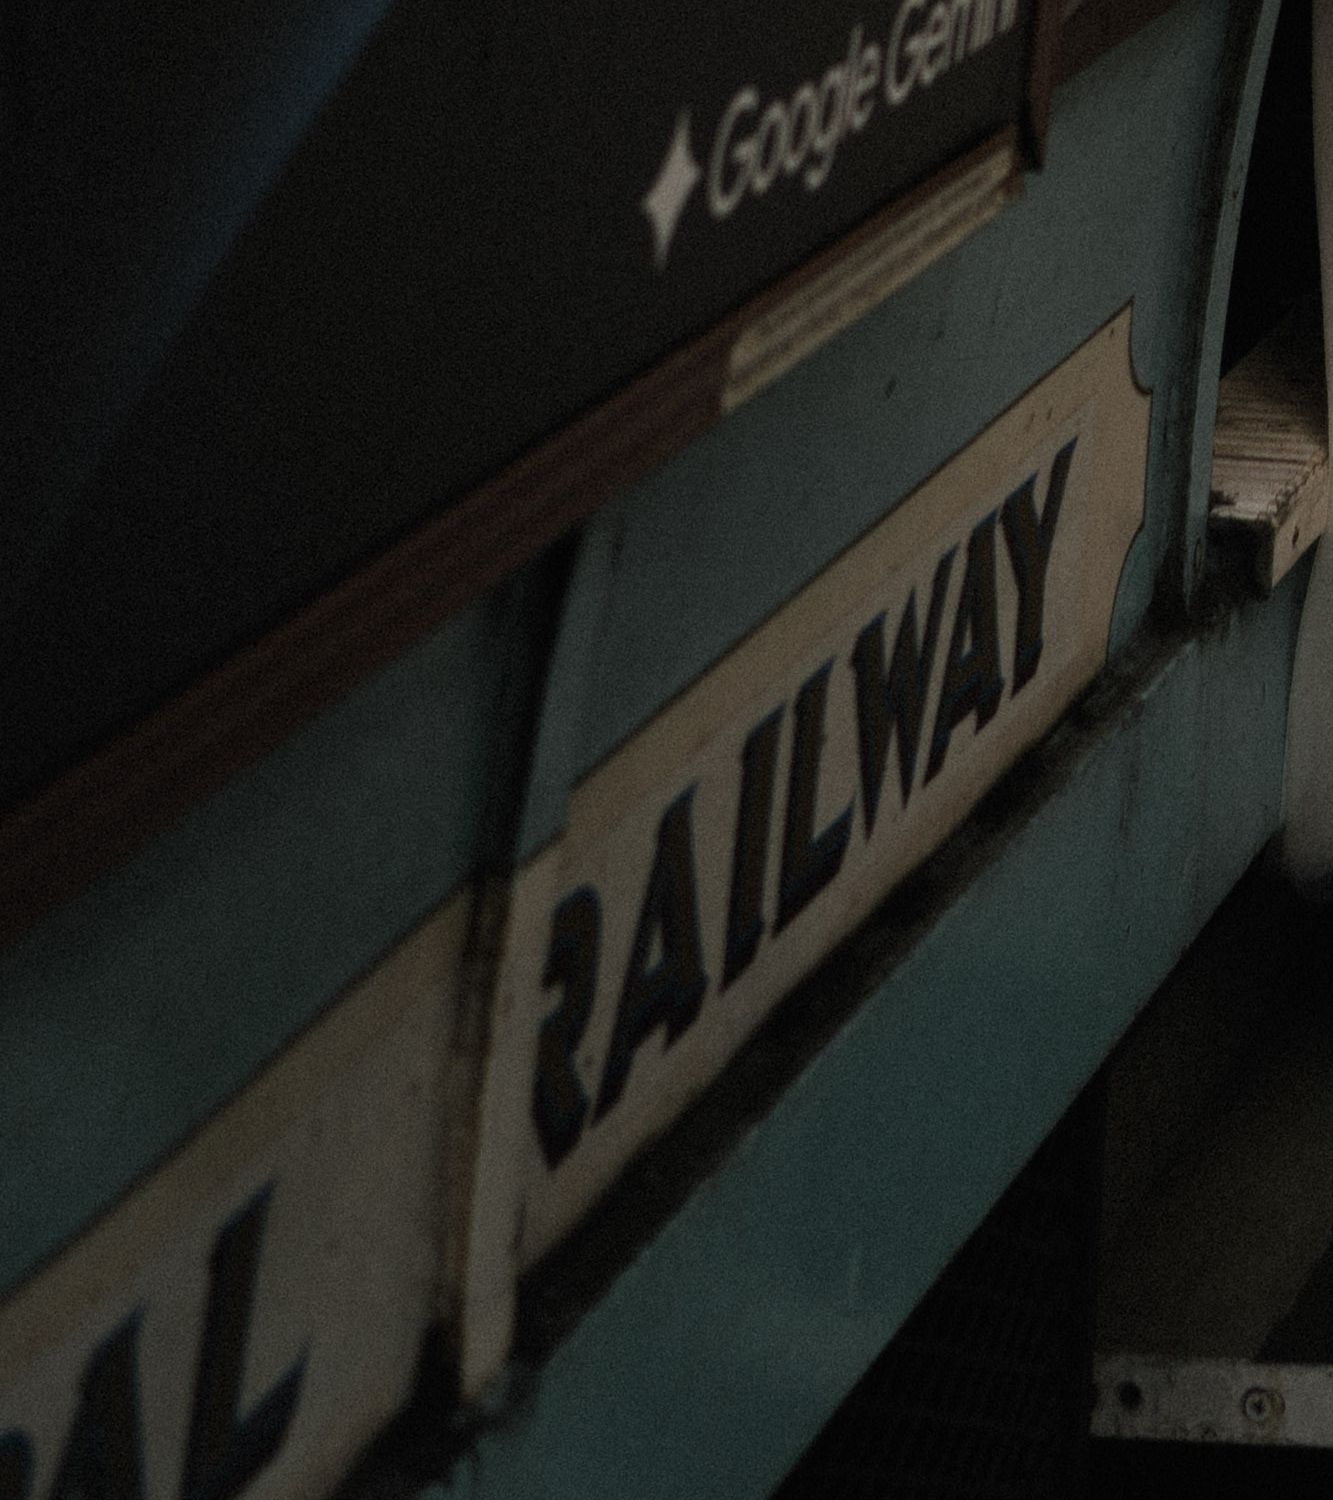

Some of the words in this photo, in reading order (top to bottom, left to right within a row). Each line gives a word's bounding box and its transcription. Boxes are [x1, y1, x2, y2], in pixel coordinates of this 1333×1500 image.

[706, 23, 884, 221] Google
[0, 1174, 311, 1500] AL
[532, 435, 1080, 1171] RAILWAY
